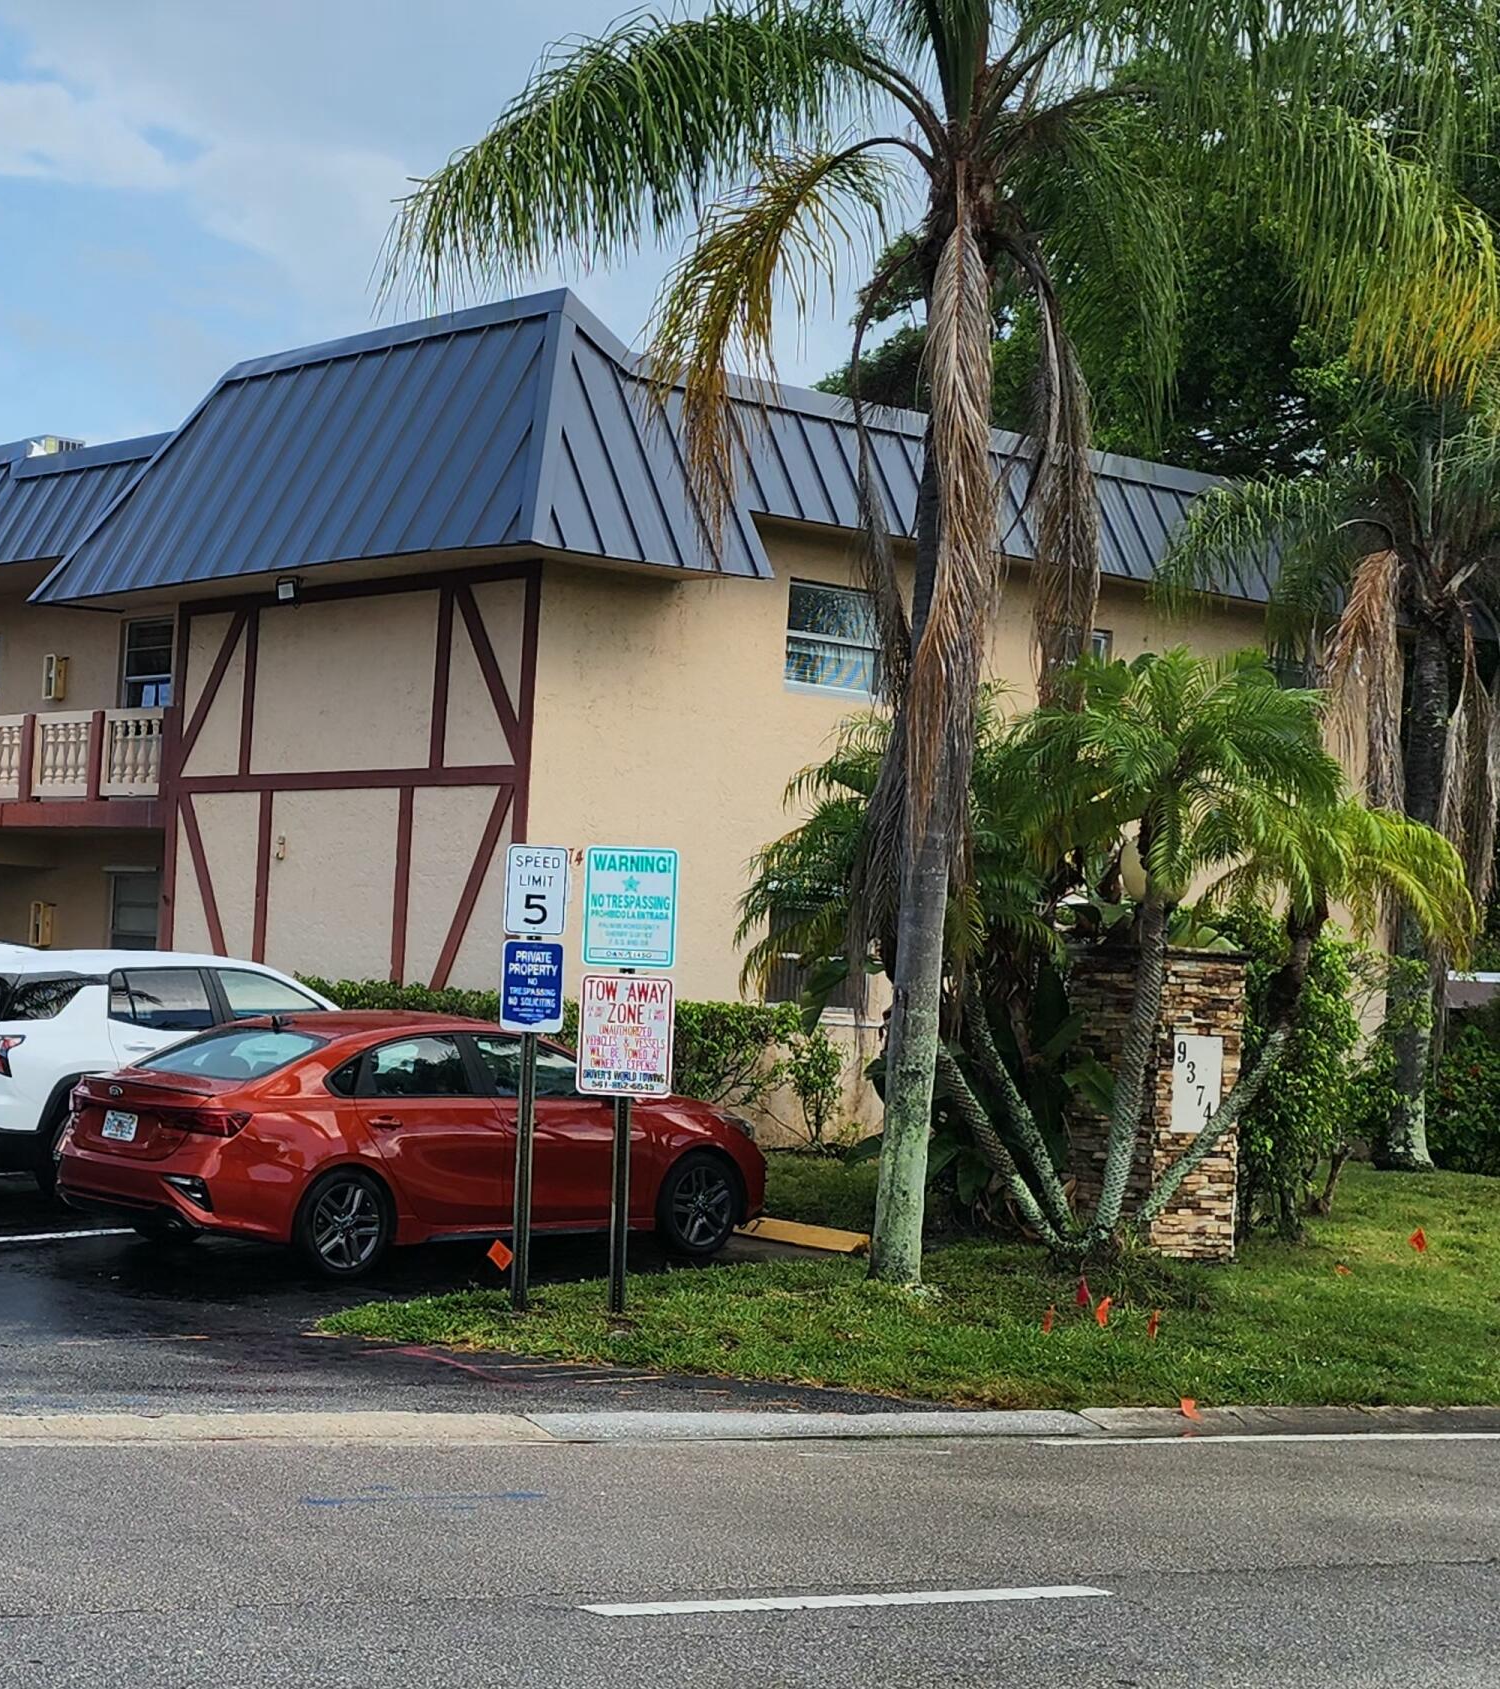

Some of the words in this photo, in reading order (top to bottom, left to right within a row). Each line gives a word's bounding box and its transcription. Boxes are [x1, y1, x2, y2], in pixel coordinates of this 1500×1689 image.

[516, 854, 561, 869] SPEED
[593, 853, 672, 874] WARNING!
[518, 873, 554, 888] LIMIT
[522, 893, 548, 925] 5
[590, 893, 605, 908] NO
[605, 894, 671, 911] TRESPASSING
[626, 910, 636, 920] LA
[515, 949, 553, 964] PRIVATE
[508, 962, 559, 977] PROPERTY
[527, 977, 538, 986] NO
[509, 986, 557, 997] TRESPASSING
[587, 980, 618, 1001] TOW
[627, 981, 667, 1003] AWAY
[507, 996, 518, 1006] NO
[520, 997, 556, 1009] SOLICITING
[607, 1003, 645, 1025] ZONE
[599, 1024, 653, 1038] UNAUTHORIZED
[585, 1034, 618, 1047] VEHICLES
[635, 1037, 666, 1050] VESSELS
[589, 1046, 605, 1058] WILL
[610, 1047, 619, 1059] BE
[622, 1048, 648, 1060] TOWED
[626, 1060, 658, 1072] EXPENSE
